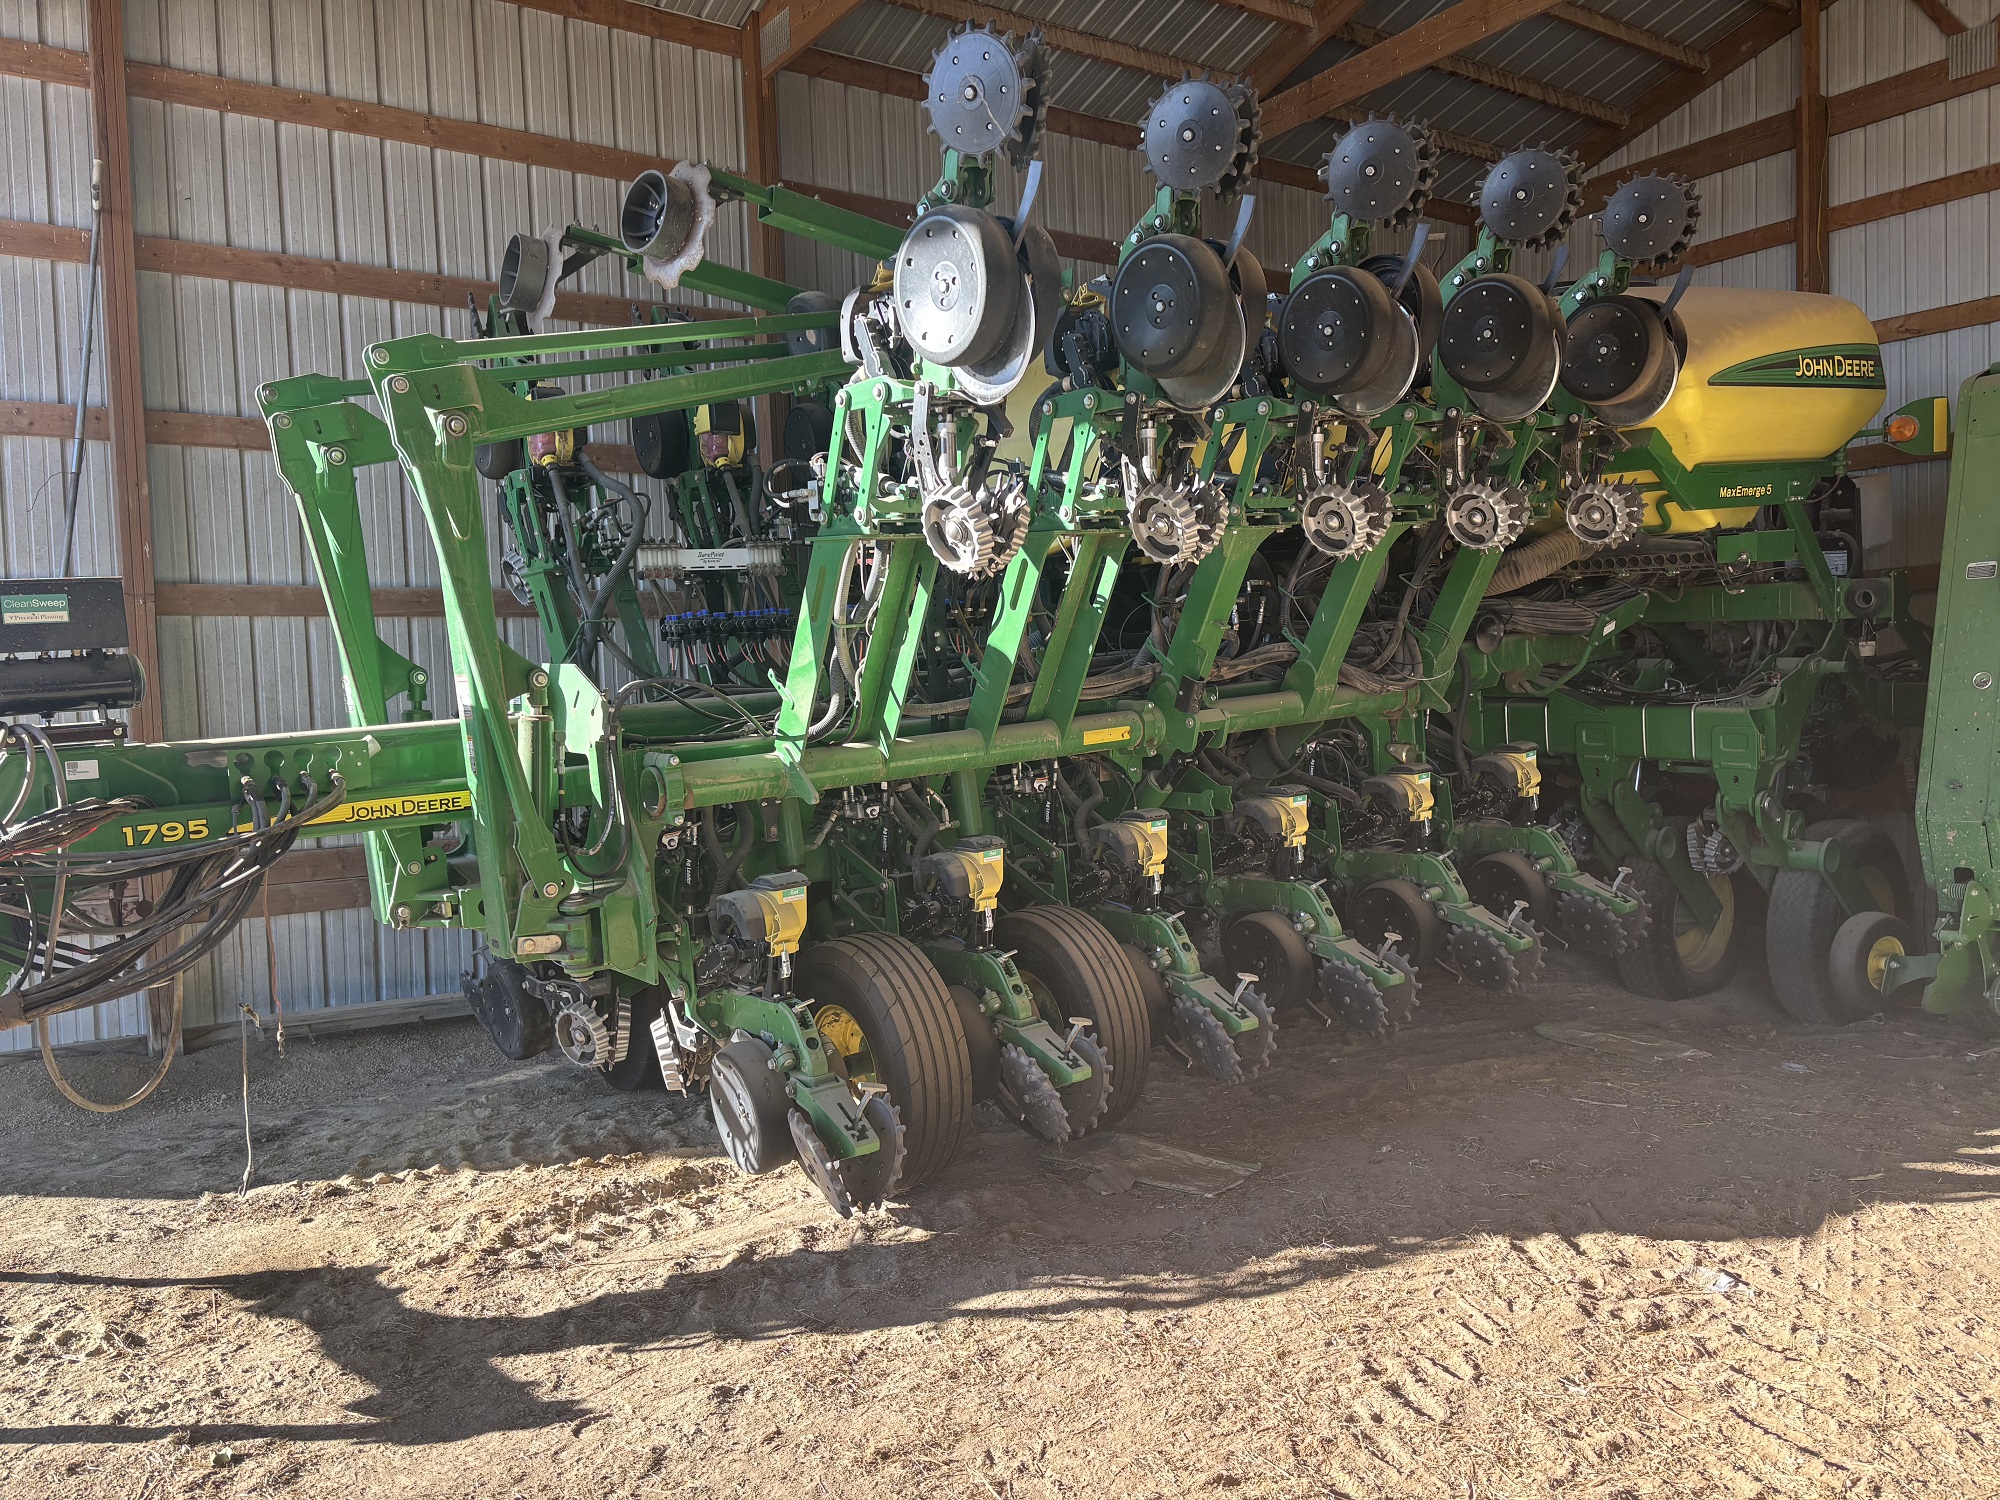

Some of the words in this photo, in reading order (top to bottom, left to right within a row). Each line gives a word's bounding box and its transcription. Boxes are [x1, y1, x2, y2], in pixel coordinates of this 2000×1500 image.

[1795, 354, 1833, 377] JOHN
[1834, 355, 1875, 377] DEERE
[1719, 485, 1766, 498] MaxEmerge
[1766, 483, 1772, 495] 5
[3, 599, 66, 609] CleanSweep
[345, 803, 397, 821] JOHN
[401, 796, 462, 814] DEERE
[121, 818, 210, 847] 1795
[686, 858, 692, 867] Ag
